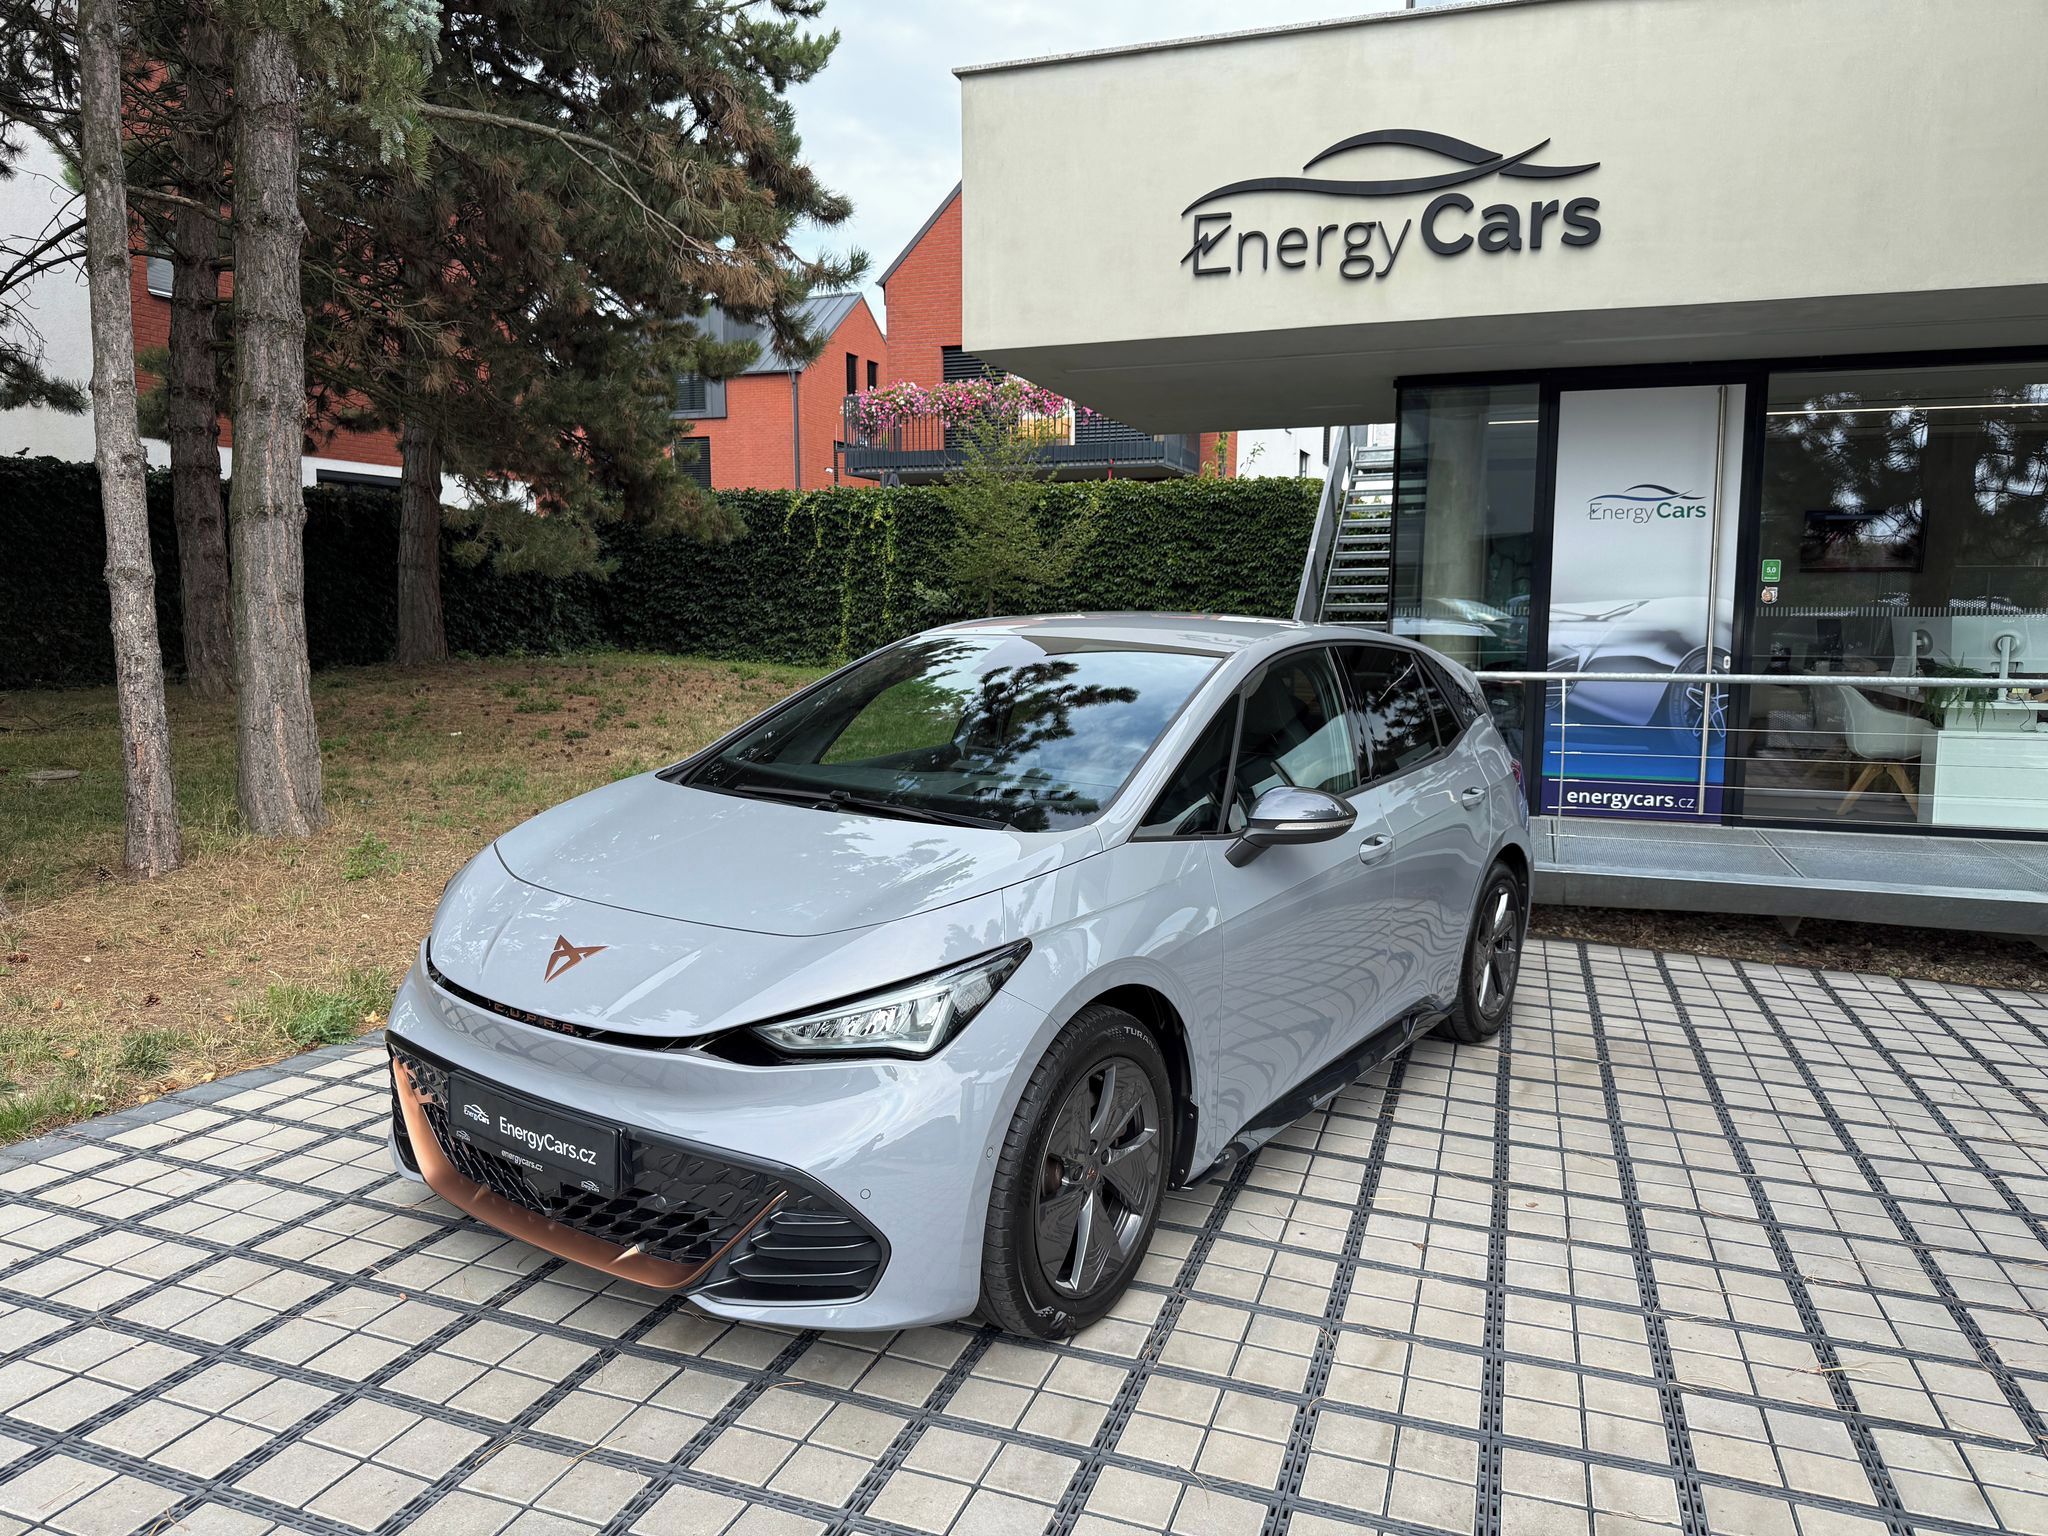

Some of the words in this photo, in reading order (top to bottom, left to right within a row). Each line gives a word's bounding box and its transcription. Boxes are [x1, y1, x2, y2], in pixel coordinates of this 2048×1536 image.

[1566, 790, 1696, 810] energycars.cz
[499, 1115, 597, 1166] EnergyCars.cz
[501, 1149, 544, 1173] energycars.cz
